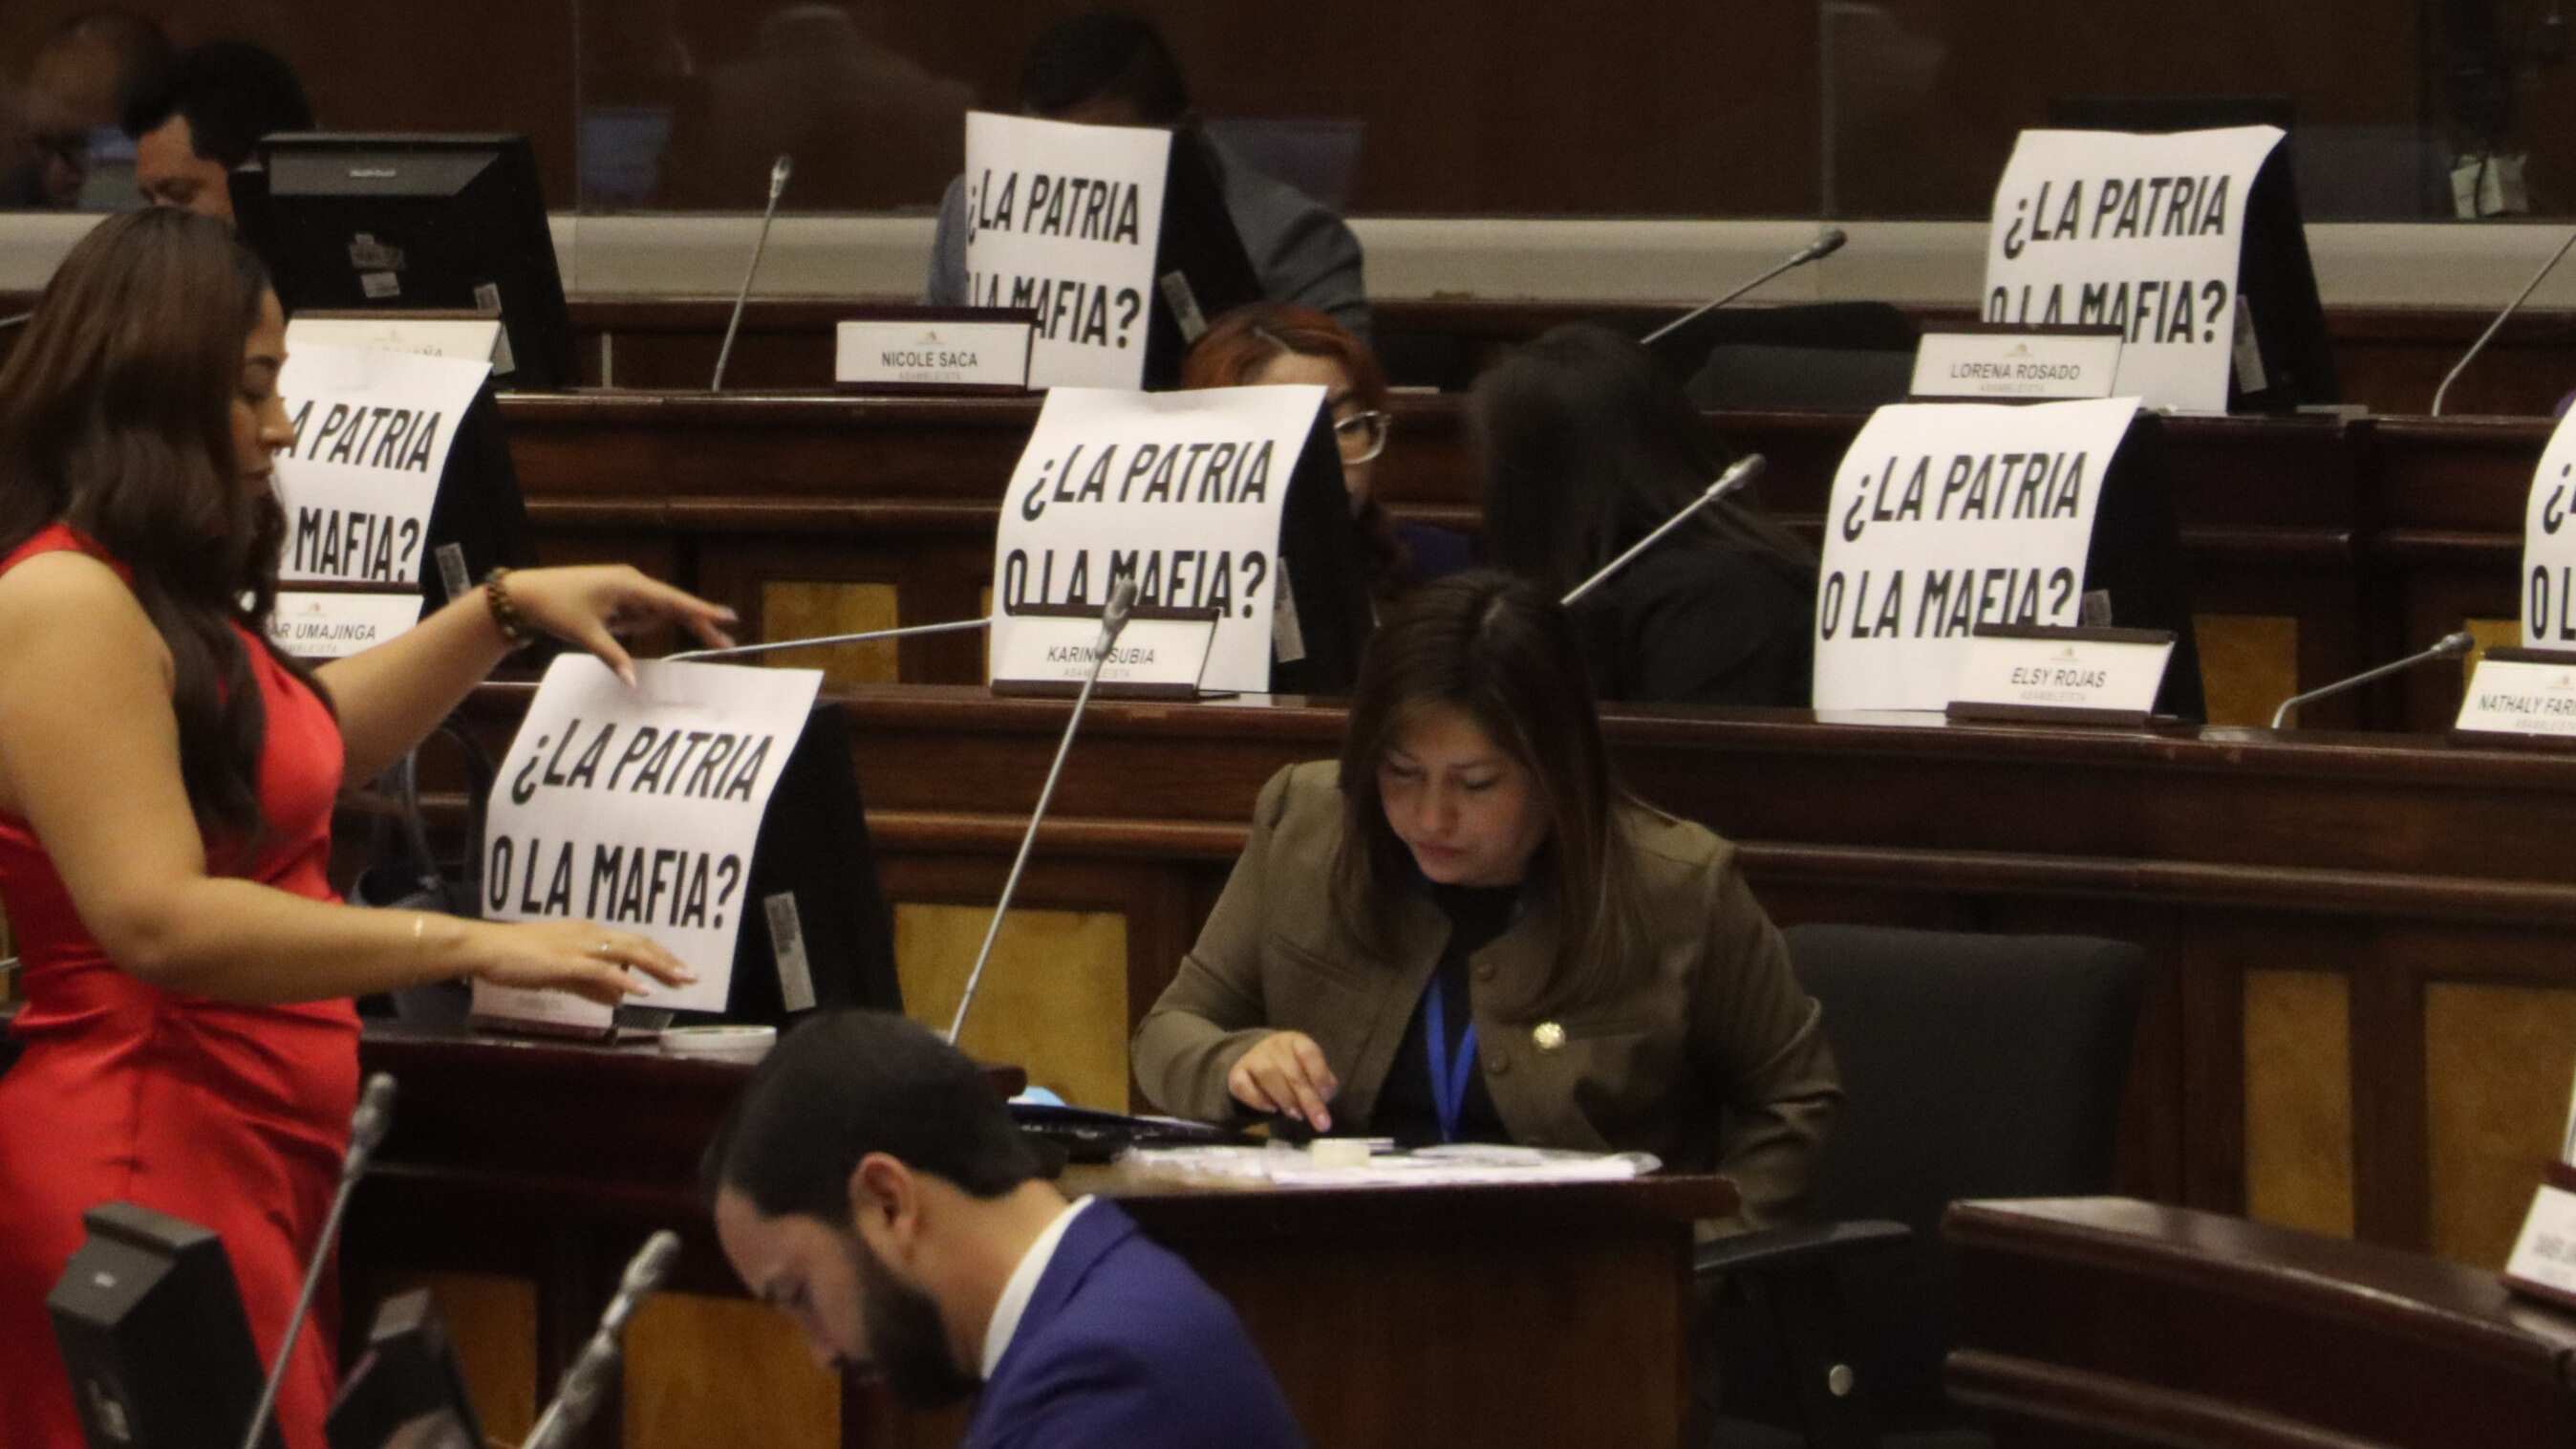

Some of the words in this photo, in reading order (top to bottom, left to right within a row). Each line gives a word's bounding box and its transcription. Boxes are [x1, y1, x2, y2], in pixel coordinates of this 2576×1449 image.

[967, 169, 1018, 248] ¿LA
[1022, 175, 1140, 246] PATRIA
[2003, 179, 2084, 260] ¿LA
[2090, 175, 2231, 241] PATRIA
[881, 351, 934, 368] NICOLE
[939, 352, 978, 368] SACA
[1949, 362, 2011, 379] LORENA
[2015, 363, 2082, 380] ROSADO
[308, 403, 442, 473] PATRIA
[1021, 444, 1119, 522] ¿LA
[1117, 440, 1276, 504] PATRIA
[1842, 455, 1931, 543] ¿LA
[1936, 451, 2088, 521] PATRIA
[294, 506, 420, 583] MAFIA?
[1104, 549, 1267, 619] MAFIA?
[1821, 571, 1845, 641] O
[1851, 570, 1904, 639] LA
[1914, 567, 2074, 639] MAFIA?
[2531, 565, 2549, 641] O
[295, 622, 376, 640] UMAJINGA
[1046, 645, 1104, 663] KARIN
[1107, 647, 1155, 665] SUBIA
[2009, 666, 2051, 686] ELSY
[2053, 668, 2108, 688] ROJAS
[511, 719, 617, 806] ¿LA
[607, 726, 775, 803] PATRIA
[489, 834, 514, 914] O
[520, 838, 575, 917] LA
[586, 843, 742, 931] MAFIA?
